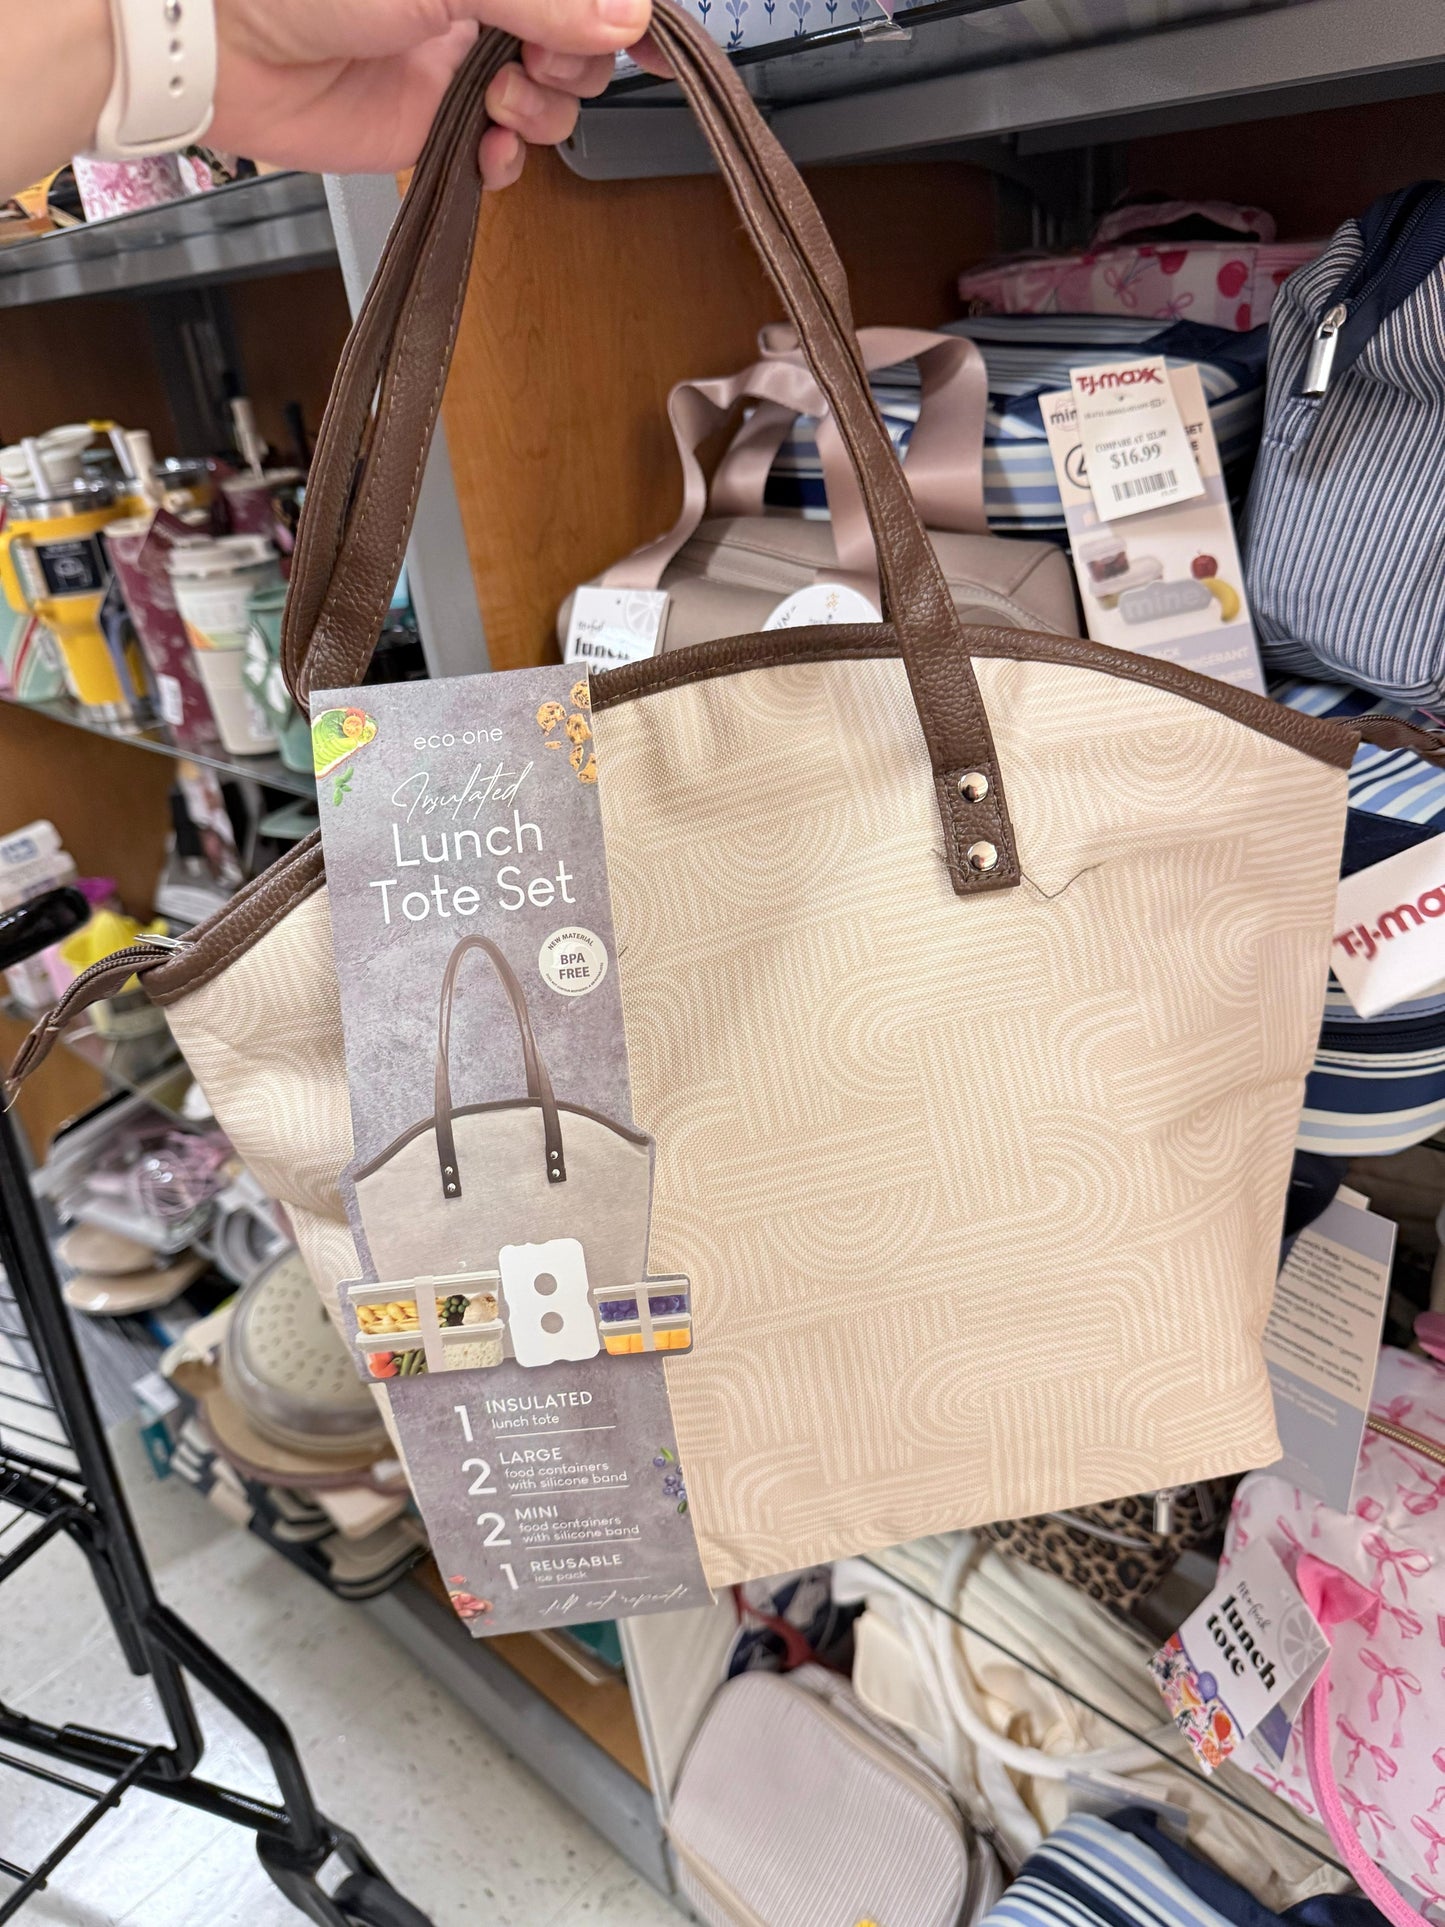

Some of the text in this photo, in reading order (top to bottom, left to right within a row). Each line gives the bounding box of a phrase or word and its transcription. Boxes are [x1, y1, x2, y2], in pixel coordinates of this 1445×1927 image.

[1109, 443, 1162, 470] $16.99
[413, 727, 503, 750] eco one
[391, 761, 534, 823] Insulated
[392, 810, 543, 867] Lunch
[369, 861, 576, 924] Tote Set
[547, 933, 594, 950] NEW MATERIAL
[560, 953, 586, 965] BPA
[559, 966, 590, 980] FREE
[486, 1391, 593, 1414] INSULATED
[454, 1405, 474, 1442] 1
[491, 1413, 560, 1429] lunch tote
[500, 1447, 563, 1465] LARGE
[461, 1458, 497, 1496] 2
[505, 1462, 609, 1478] food containers
[508, 1470, 628, 1490] with silicone band
[514, 1505, 559, 1520] MINI
[476, 1512, 512, 1547] 2
[519, 1517, 622, 1533] food containers
[522, 1524, 640, 1544] with silicone band
[530, 1553, 623, 1573] REUSABLE
[500, 1563, 519, 1591] 1
[534, 1571, 588, 1583] ice pack
[1205, 1614, 1246, 1677] tote
[1220, 1594, 1276, 1692] lunch
